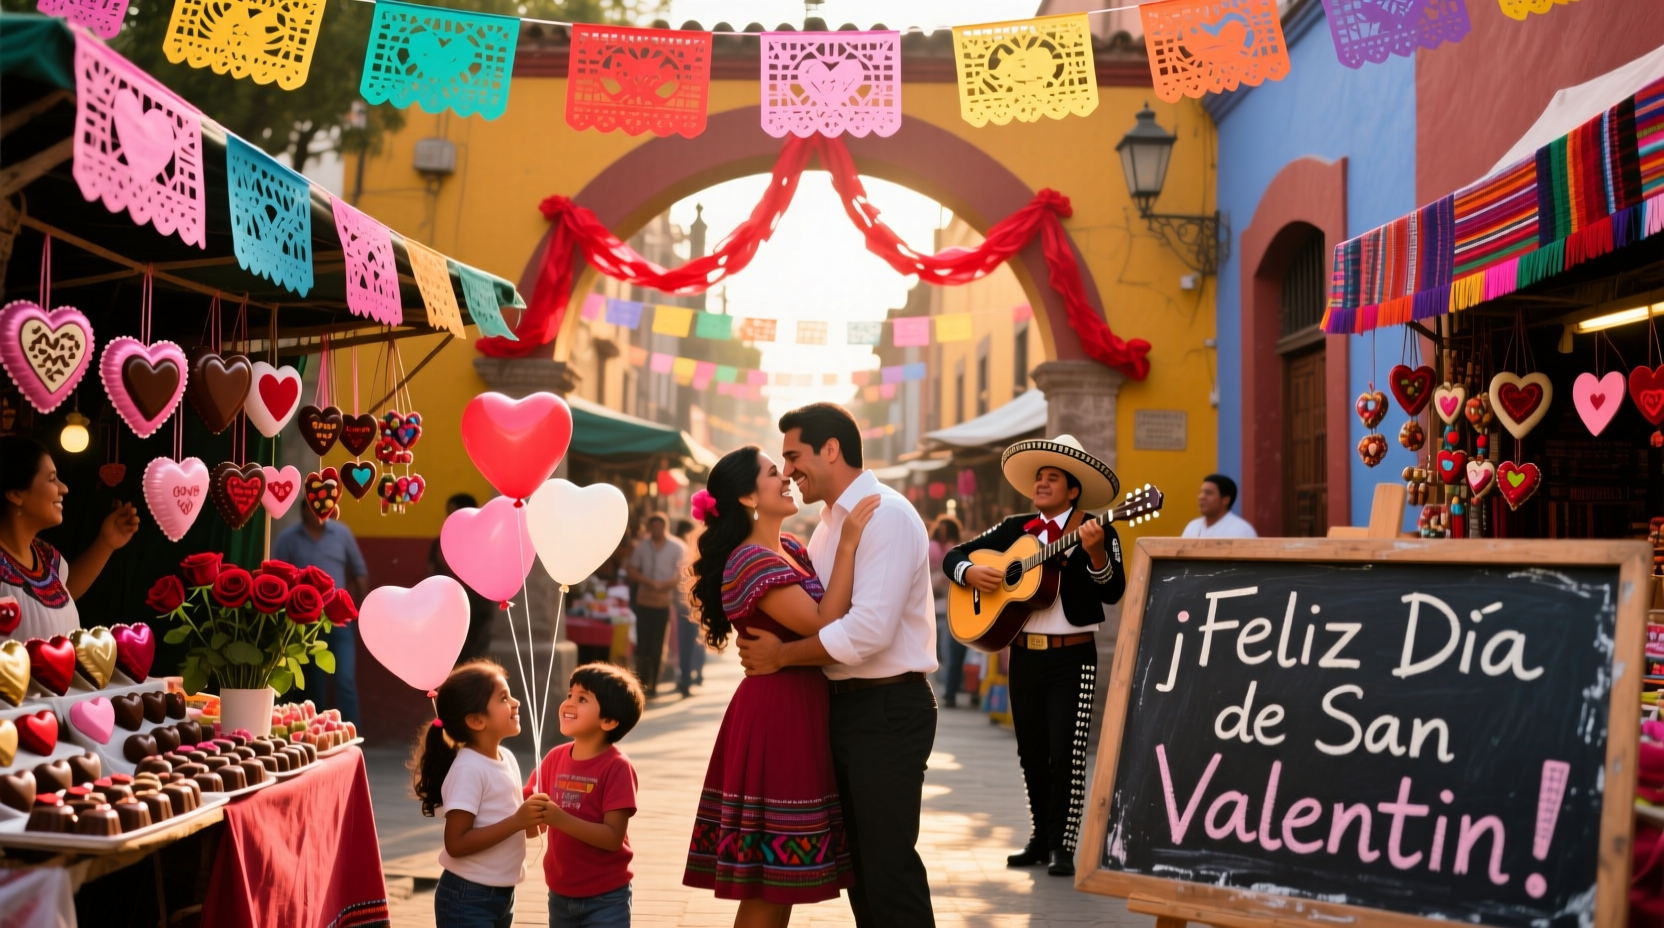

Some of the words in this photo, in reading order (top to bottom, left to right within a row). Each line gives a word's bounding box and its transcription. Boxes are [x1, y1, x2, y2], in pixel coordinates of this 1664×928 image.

[1155, 585, 1364, 693] ¡Feliz
[1391, 591, 1546, 681] Día
[1214, 680, 1286, 746] de
[1314, 683, 1456, 763] San
[1155, 743, 1571, 898] Valentin!
